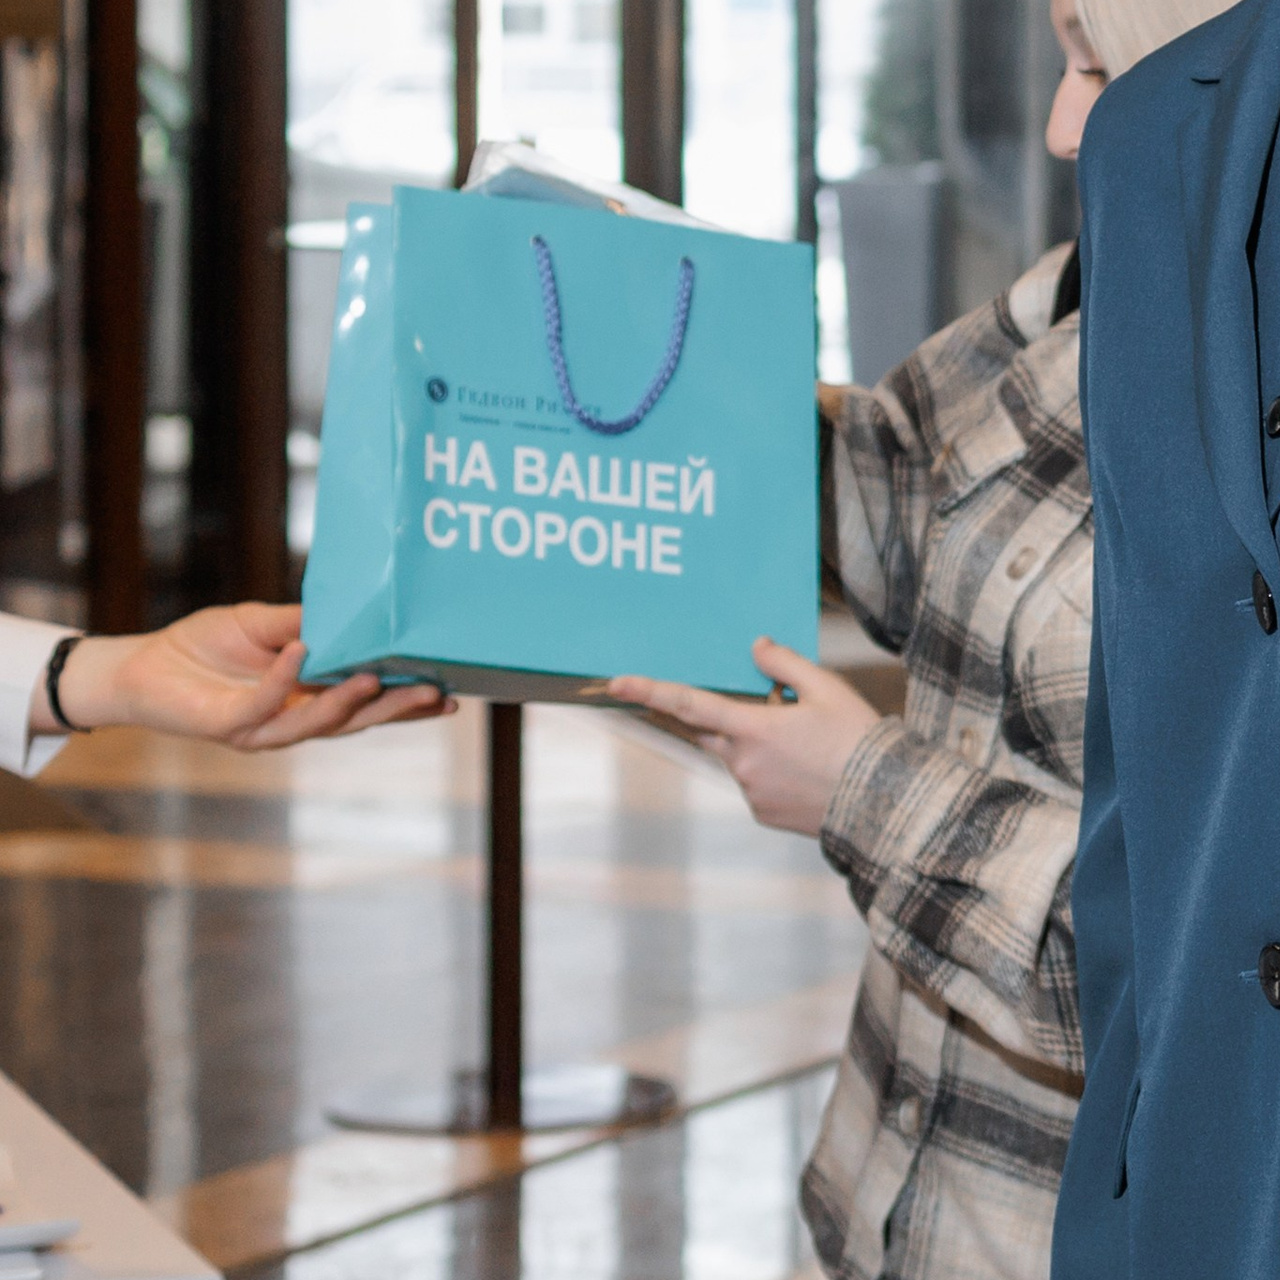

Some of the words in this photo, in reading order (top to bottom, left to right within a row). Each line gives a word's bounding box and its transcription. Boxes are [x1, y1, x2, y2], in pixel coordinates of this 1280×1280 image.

[424, 433, 497, 492] НА
[513, 445, 715, 516] ВАШЕЙ
[423, 497, 683, 576] СТОРОНЕ
